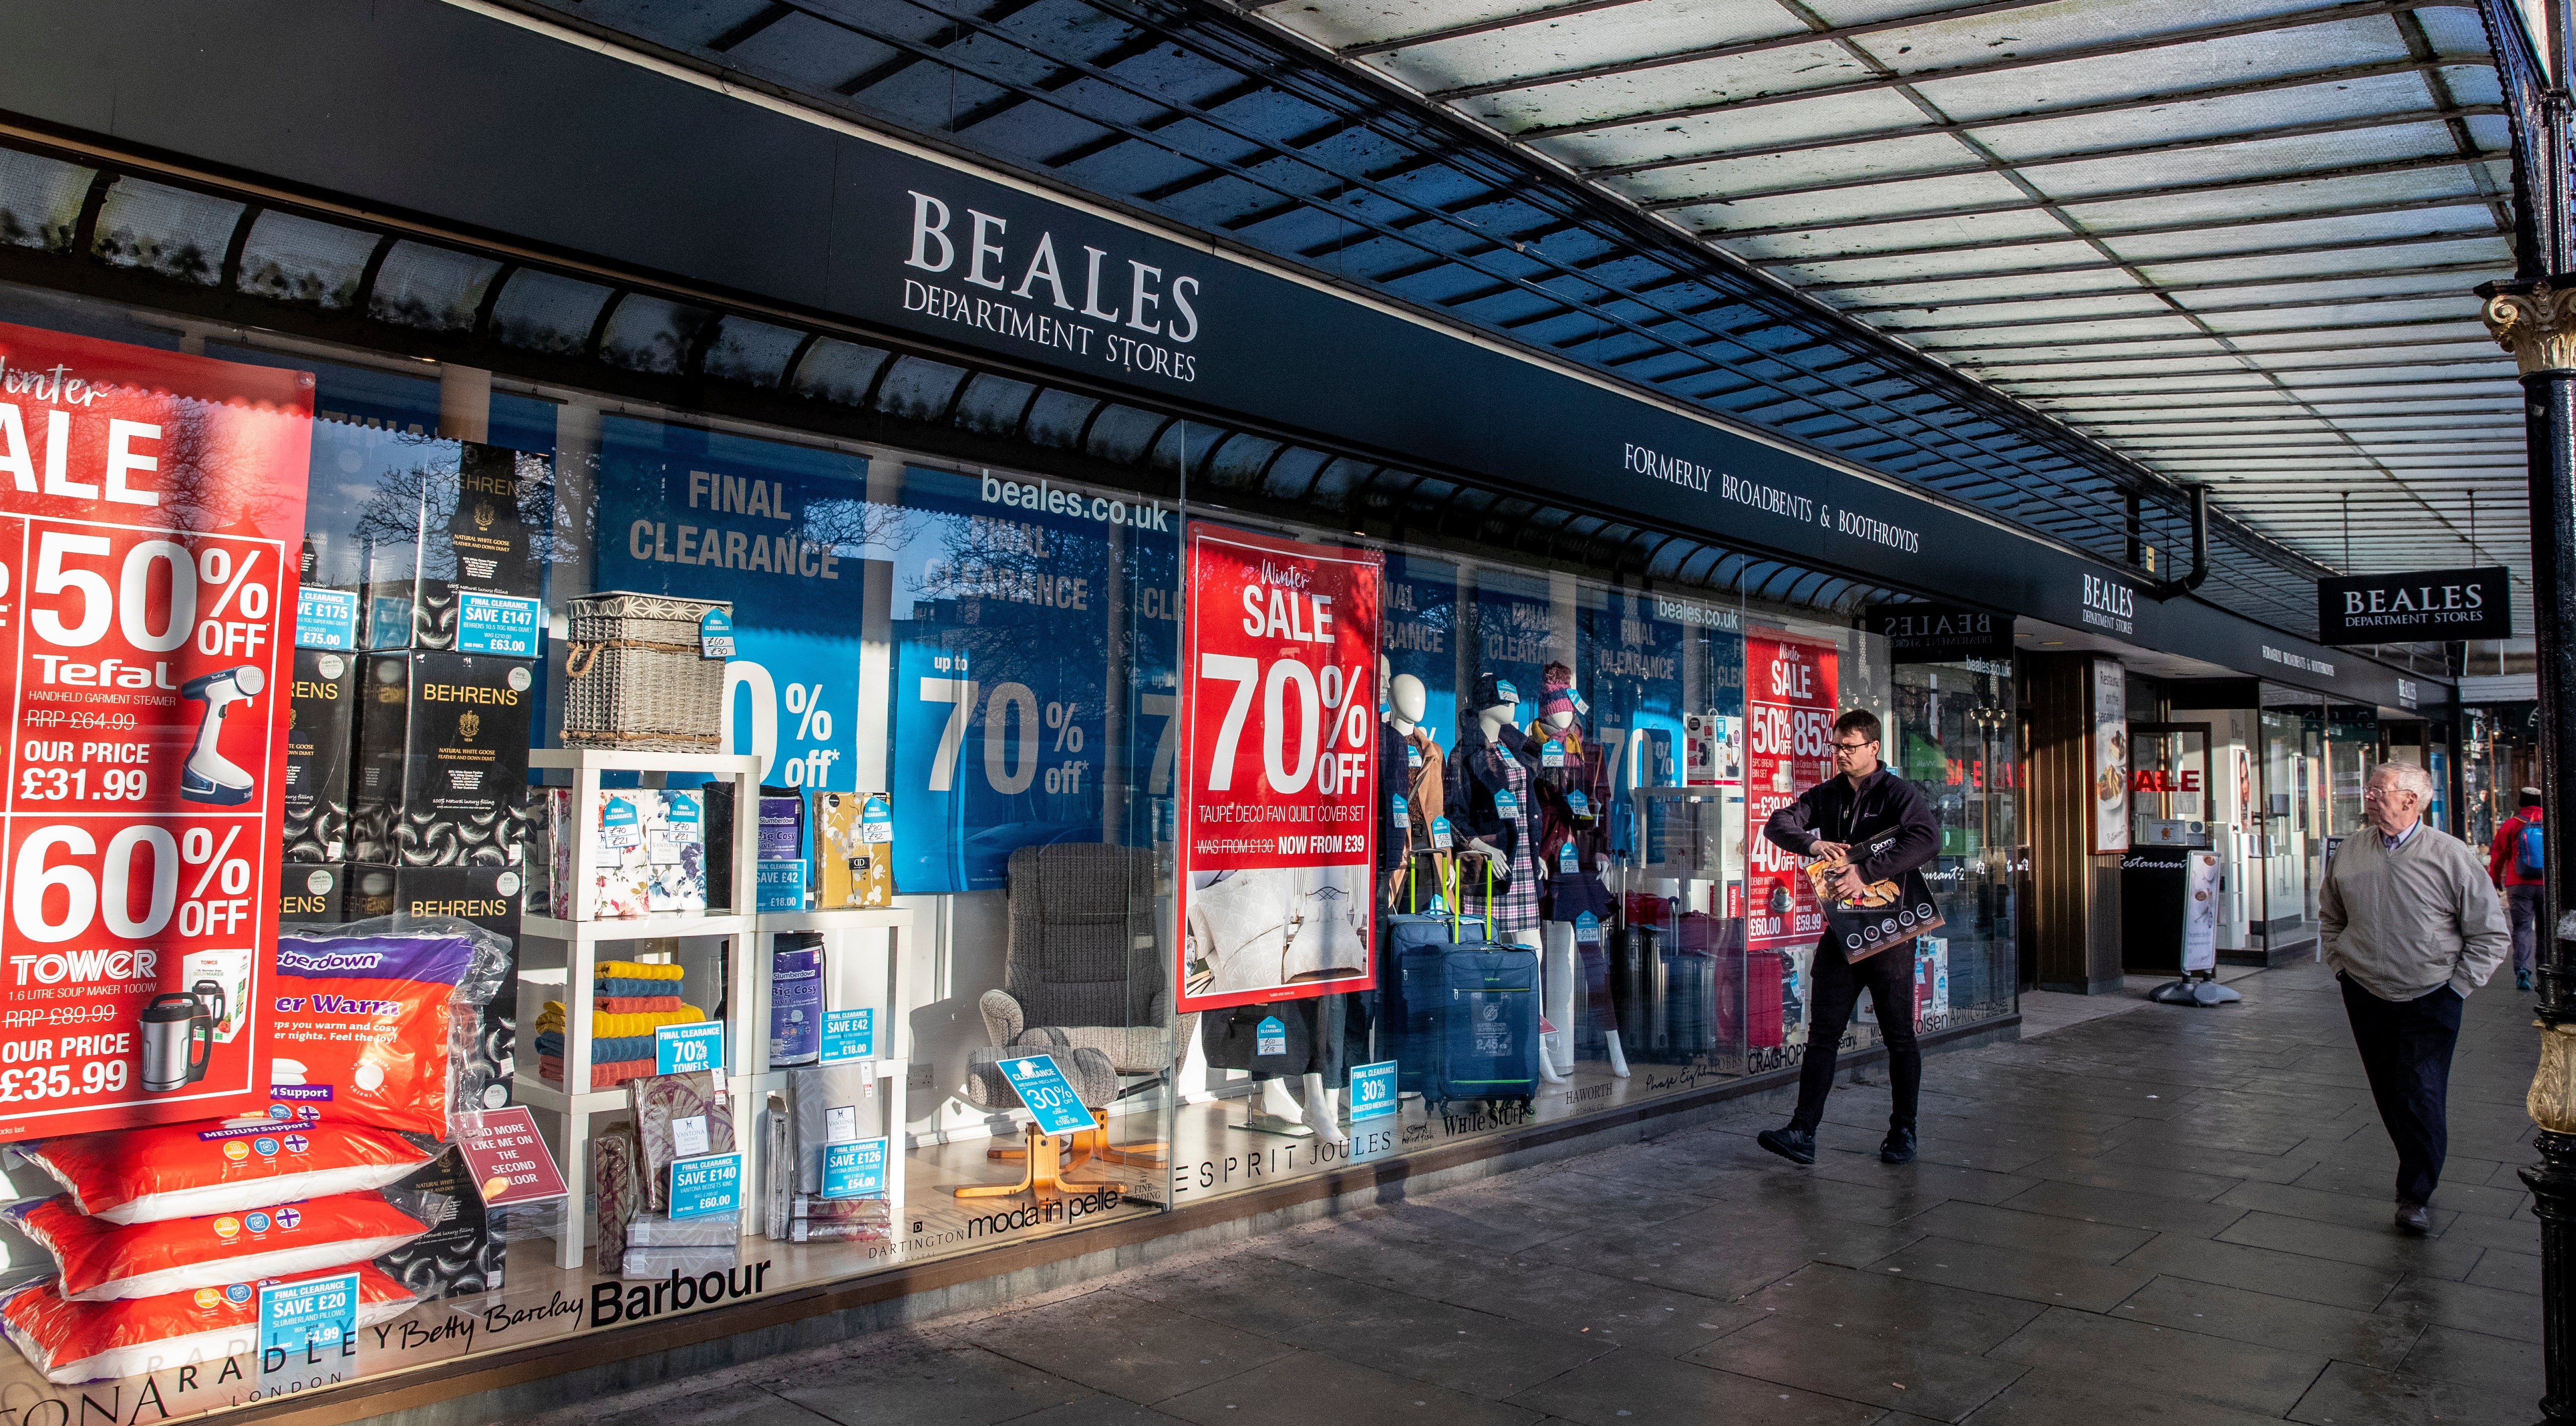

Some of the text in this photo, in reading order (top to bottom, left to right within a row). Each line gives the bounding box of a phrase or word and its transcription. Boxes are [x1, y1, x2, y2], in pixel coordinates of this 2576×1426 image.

[904, 190, 1199, 342] BEALES
[903, 279, 1195, 382] DEPARTMENT STORES
[0, 356, 107, 407] inter
[0, 402, 162, 506] ALE
[690, 471, 791, 520] FINAL
[982, 469, 1168, 532] beales.co.uk
[1625, 443, 1918, 553] FORMERLY BROADBENTS & BOOTHROYDS
[971, 514, 1048, 558] FINAL
[630, 519, 839, 580] CLEARANCE
[1261, 558, 1309, 588] Winter
[31, 531, 269, 652] 50%
[2083, 574, 2133, 618] BEALES
[2343, 584, 2482, 614] BEALES
[316, 604, 348, 619] £175
[471, 597, 528, 609] FINAL CLEARANCE
[1659, 595, 1738, 630] beales.co.uk
[466, 607, 532, 625] SAVE £147
[1243, 584, 1335, 643] SALE
[2083, 609, 2133, 634] DEPARTMENT STORES
[2345, 611, 2483, 627] DEPARTMENT STORES
[303, 632, 340, 645] £75.00
[707, 637, 724, 647] £60
[1620, 619, 1656, 646] FINAL
[490, 639, 525, 652] £63.00
[710, 647, 727, 655] £30
[1780, 642, 1801, 661] Winter
[33, 654, 177, 690] Tefal
[1966, 654, 2011, 678] beales.co.uk
[1771, 659, 1812, 699] SALE
[29, 691, 176, 706] HANDHELD GARMENT STEAMER
[424, 684, 518, 705] BEHRENS
[26, 710, 135, 730] RRP £64.99
[1201, 653, 1367, 794] 70%
[1753, 706, 1791, 754] 50%
[920, 677, 1084, 794] 70%
[1794, 710, 1833, 757] 85%
[24, 740, 149, 764] OUR PRICE
[1780, 739, 1791, 755] OFF
[1600, 727, 1674, 801] 70%
[21, 768, 147, 801] £31.99
[1199, 805, 1365, 822] TAUPE DECO FAN QUILT COVER SET
[609, 826, 626, 836] £70
[674, 822, 690, 831] £70
[777, 831, 796, 842] Cosy
[867, 823, 882, 832] £80
[612, 837, 628, 846] £21
[1278, 835, 1365, 854] NOW FROM £39
[1871, 837, 1896, 852] George
[1781, 856, 1794, 871] OFF
[13, 824, 250, 942] 60%
[782, 872, 798, 883] £42
[411, 900, 507, 918] BEHRENS
[771, 897, 796, 907] £18.00
[1750, 917, 1780, 936] £60.00
[1796, 914, 1821, 931] £59.99
[10, 949, 157, 986] TOWER
[773, 969, 815, 980] Slumberdown
[8, 983, 157, 1001] 1.6 LITRE SOUP MAKER 1000W
[794, 984, 818, 995] Cosy
[312, 995, 401, 1015] Warm
[842, 1010, 867, 1019] CLEARANCE
[5, 1004, 115, 1028] RRP £89.99
[827, 1019, 868, 1033] SAVE £42
[1916, 1013, 1948, 1034] olsen
[315, 1022, 370, 1031] warm and
[660, 1027, 720, 1040] FINAL CLEARANCE
[3, 1032, 129, 1063] OUR PRICE
[672, 1039, 707, 1063] 70%
[843, 1043, 866, 1055] £18.00
[1, 1059, 128, 1102] £35.99
[1353, 1066, 1395, 1080] FINAL CLEARANCE
[1646, 1066, 1707, 1092] Phase Eight
[280, 1087, 328, 1098] Support
[1026, 1085, 1073, 1109] 30%
[1361, 1078, 1385, 1101] 30%
[1566, 1083, 1613, 1104] HAWORTH
[1352, 1099, 1395, 1113] SELECTED MENSWEAR
[204, 1122, 310, 1138] MEDIUM Support
[494, 1123, 527, 1136] MORE
[497, 1135, 534, 1149] ME ON
[849, 1142, 879, 1152] CLEARANCE
[1310, 1131, 1391, 1165] JOULES
[496, 1150, 520, 1160] THE
[682, 1158, 733, 1171] FINAL CLEARANCE
[830, 1151, 881, 1168] SAVE £126
[491, 1161, 536, 1174] SECOND
[677, 1166, 736, 1186] SAVE £140
[1175, 1145, 1296, 1192] ESPRIT
[501, 1173, 539, 1187] FLOOR
[848, 1176, 875, 1189] £54.00
[700, 1194, 730, 1209] £60.00
[968, 1186, 1118, 1239] moda in pelle
[869, 1229, 964, 1259] DARTINGTON
[275, 1281, 346, 1300] FINAL CLEARANCE
[590, 1259, 772, 1328] Barbour
[273, 1292, 346, 1318] SAVE £20
[273, 1309, 346, 1328] SLUMBERLAND PILLOWS
[400, 1290, 584, 1355] Betty Barclay
[178, 1325, 392, 1393] RADLEY
[232, 1371, 342, 1407] LONDON
